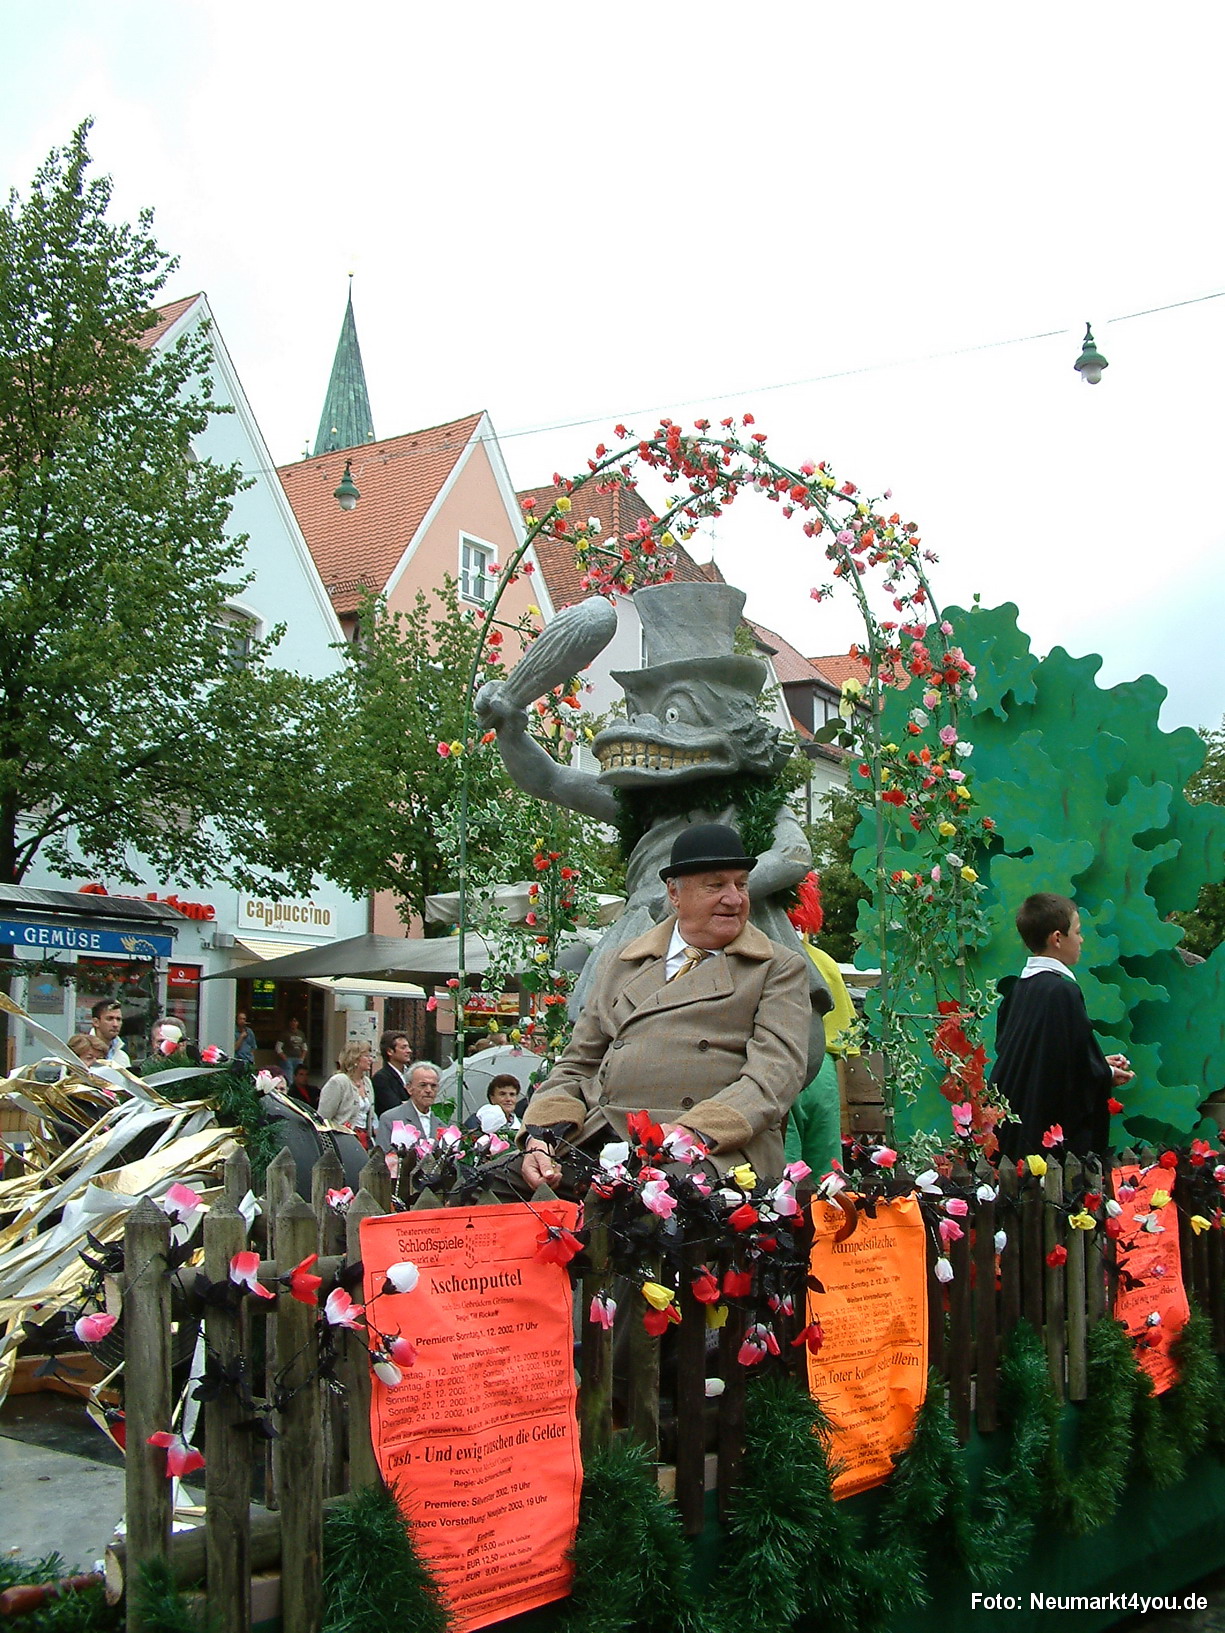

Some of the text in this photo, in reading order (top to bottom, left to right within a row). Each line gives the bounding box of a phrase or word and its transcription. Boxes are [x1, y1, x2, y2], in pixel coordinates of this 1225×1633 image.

[246, 900, 331, 927] cappuccino
[23, 926, 101, 949] GEMÜSE
[396, 1227, 441, 1237] Theaterverein
[398, 1236, 464, 1254] Schloßspiele
[430, 1269, 522, 1295] Aschenputtel
[415, 1334, 456, 1347] Premiere:
[487, 1327, 497, 1337] 12.
[516, 1322, 524, 1331] 17
[525, 1321, 539, 1331] Uhr
[550, 1349, 561, 1357] Uhr
[387, 1383, 423, 1394] Sonntag,
[551, 1359, 562, 1367] Uhr
[814, 1372, 827, 1388] Ein
[828, 1369, 853, 1384] Toter
[385, 1395, 420, 1405] Sonntag,
[425, 1445, 452, 1463] Und
[456, 1444, 482, 1462] ewig
[483, 1434, 514, 1455] rauschen
[516, 1429, 529, 1446] die
[532, 1424, 567, 1442] Gelder
[424, 1499, 470, 1510] Premiere:
[510, 1484, 518, 1493] 19
[518, 1480, 532, 1491] Uhr
[526, 1497, 535, 1507] 19
[535, 1494, 548, 1505] Uhr
[467, 1545, 479, 1557] EUR
[480, 1540, 497, 1551] 15,00
[466, 1558, 480, 1569] EUR
[481, 1553, 499, 1565] 12,50
[465, 1570, 480, 1581] EUR
